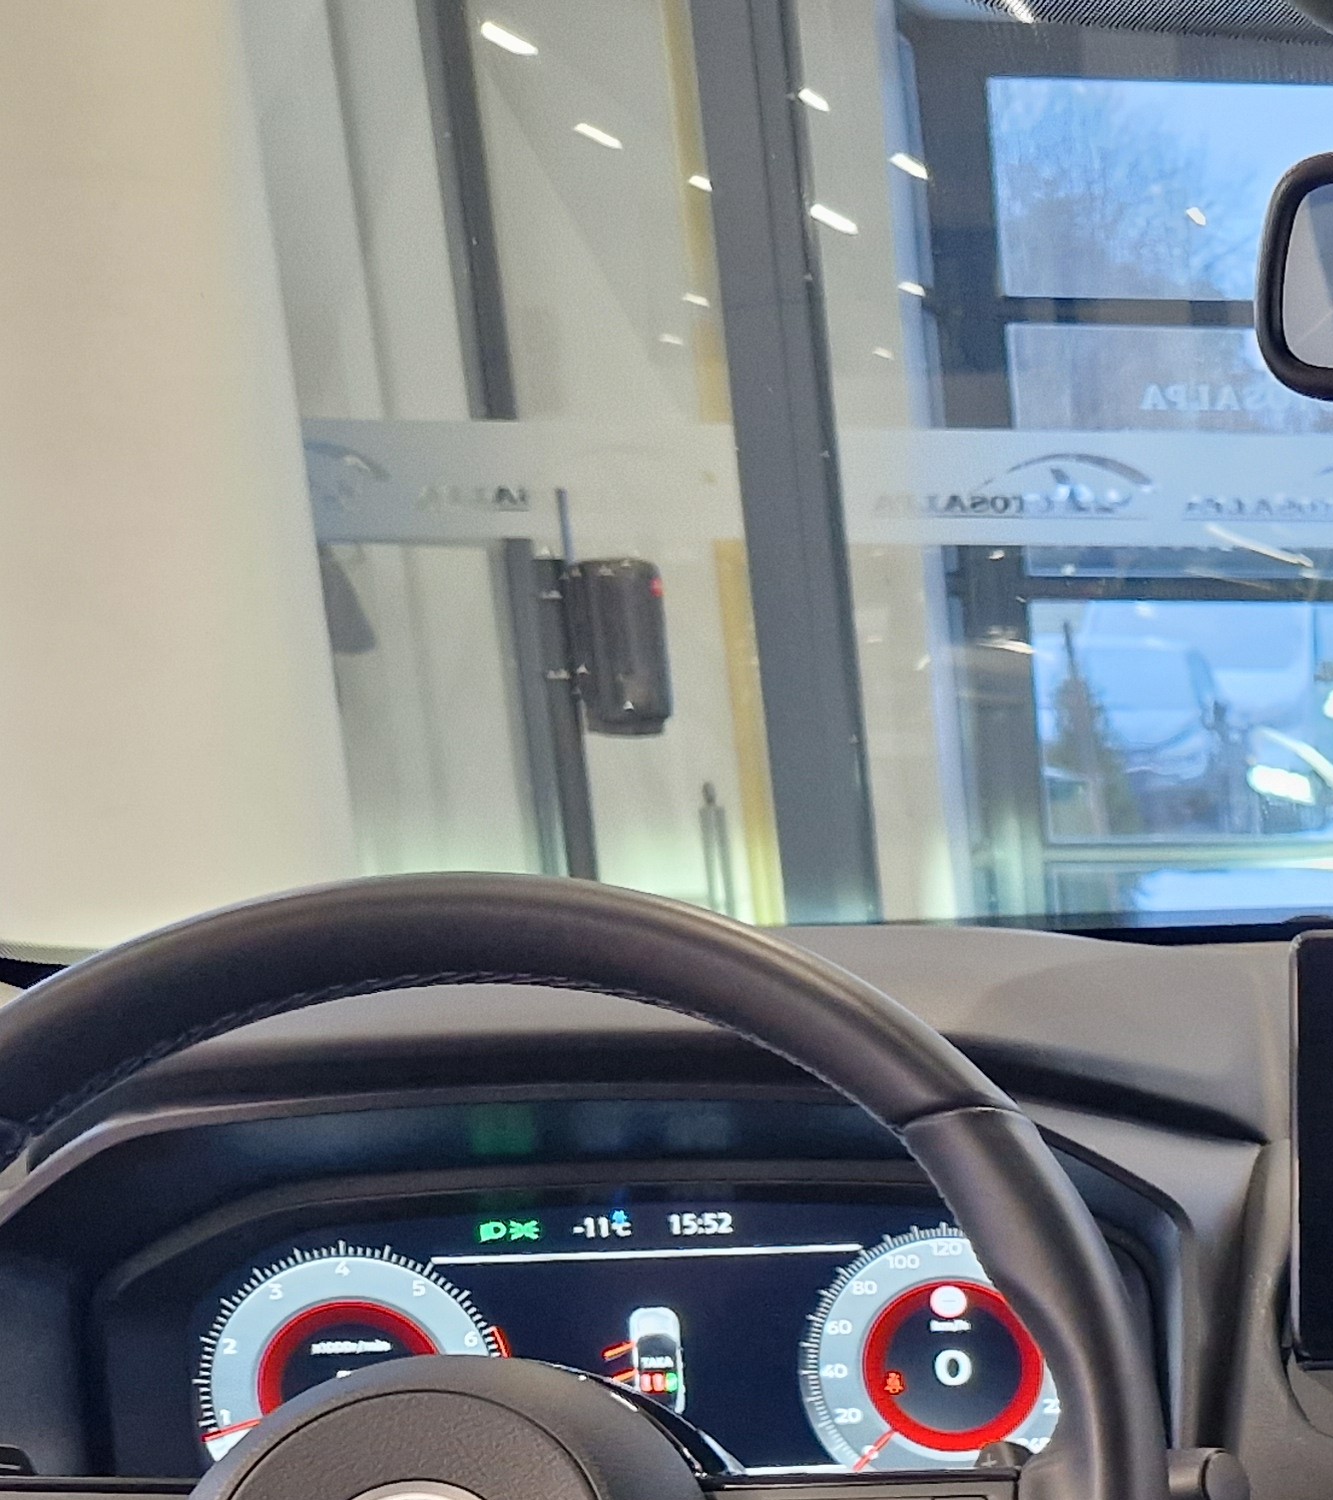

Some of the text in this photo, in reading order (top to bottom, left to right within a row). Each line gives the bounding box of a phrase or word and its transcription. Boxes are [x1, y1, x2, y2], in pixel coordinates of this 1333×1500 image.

[669, 1212, 734, 1236] 15:52
[930, 1241, 963, 1257] 120
[335, 1261, 350, 1276] 4
[886, 1254, 920, 1270] 100
[268, 1285, 283, 1300] 3
[413, 1280, 427, 1297] 5
[851, 1280, 877, 1295] 80
[826, 1319, 852, 1335] 60
[222, 1338, 237, 1354] 2
[464, 1331, 478, 1348] 6
[820, 1363, 847, 1379] 40
[934, 1349, 972, 1386] 0
[219, 1408, 231, 1425] 1
[834, 1408, 863, 1424] 20
